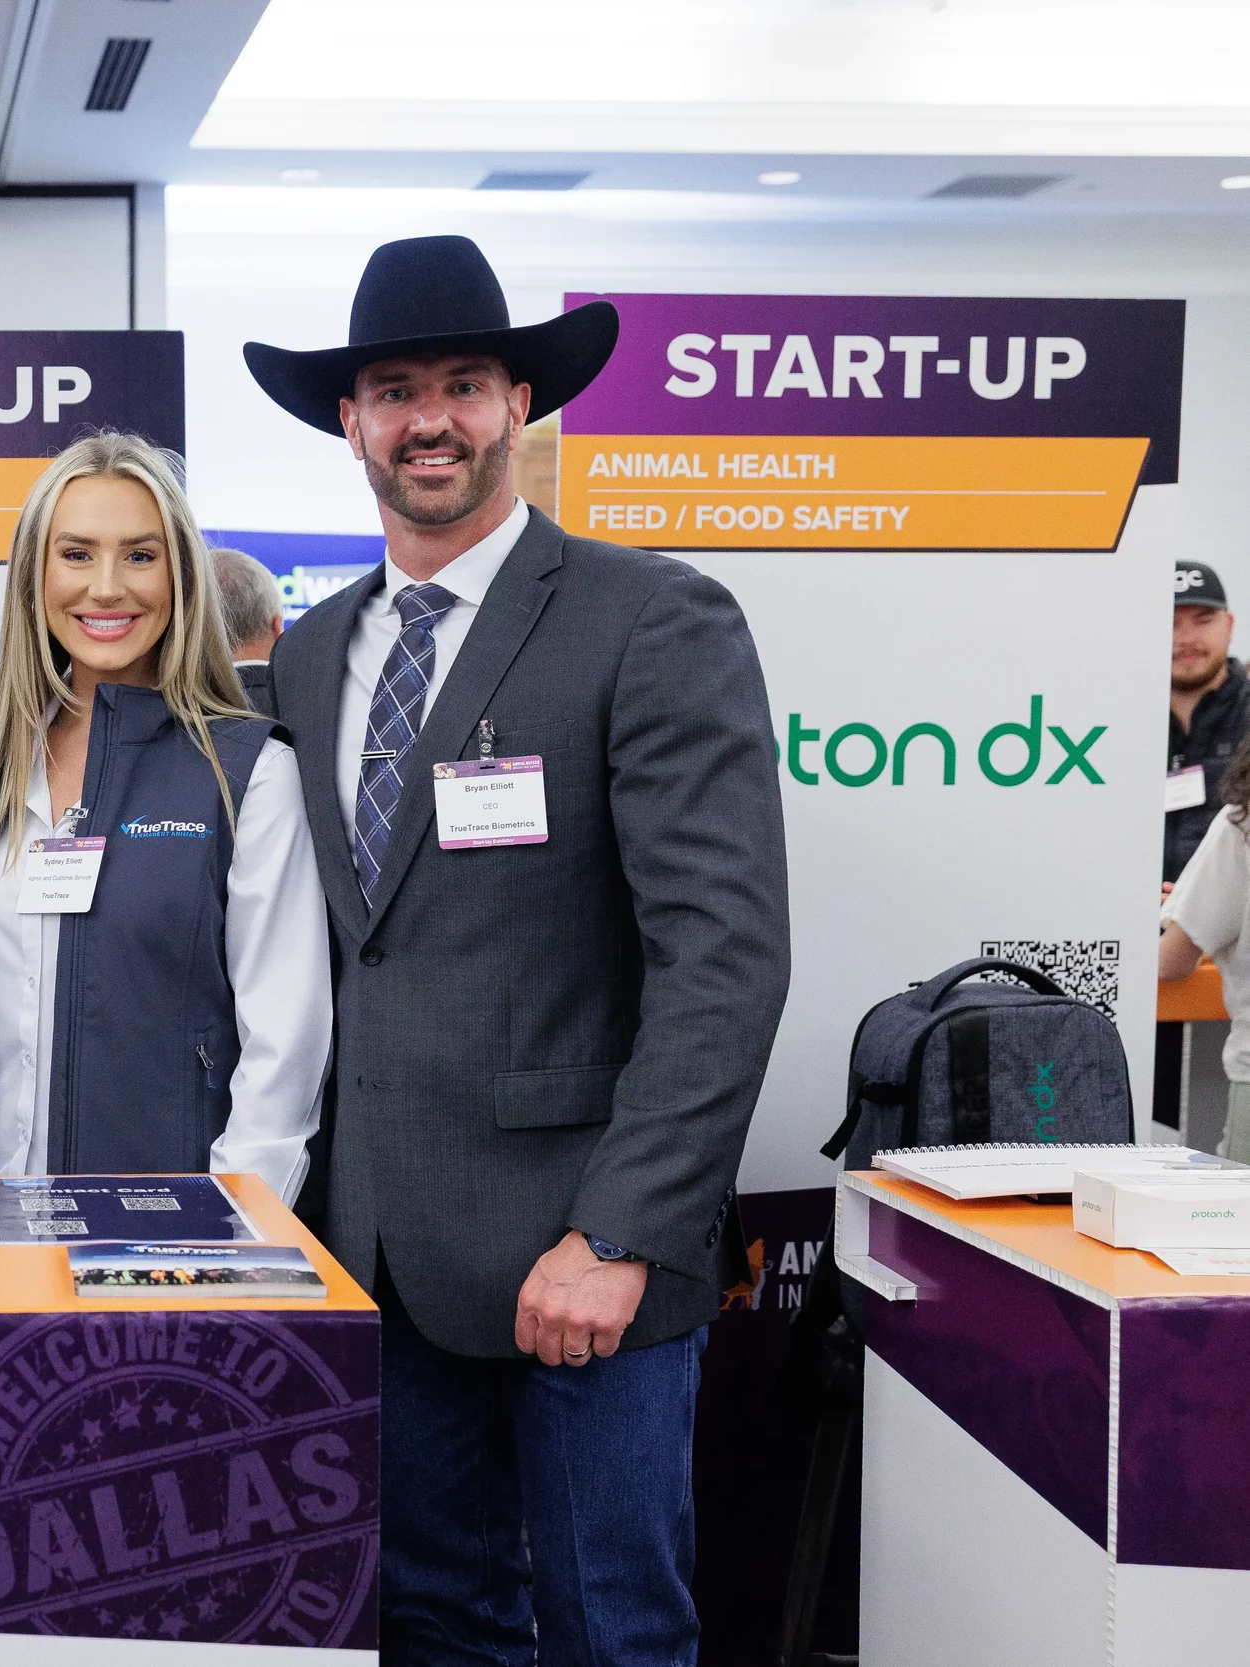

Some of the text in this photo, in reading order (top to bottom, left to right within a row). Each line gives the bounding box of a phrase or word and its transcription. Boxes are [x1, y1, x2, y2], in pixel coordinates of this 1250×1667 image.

[665, 333, 1087, 400] START-UP
[587, 453, 836, 480] ANIMAL HEALTH
[588, 504, 910, 532] FEED / FOOD SAFETY
[978, 694, 1109, 787] dx
[464, 782, 515, 793] Bryan Elliott
[130, 831, 170, 839] PERMANENT
[450, 820, 535, 833] TrueTrace Biometrics
[43, 857, 83, 867] Sydney Elliott
[1191, 1209, 1236, 1220] proton dx
[220, 1328, 290, 1399] TO
